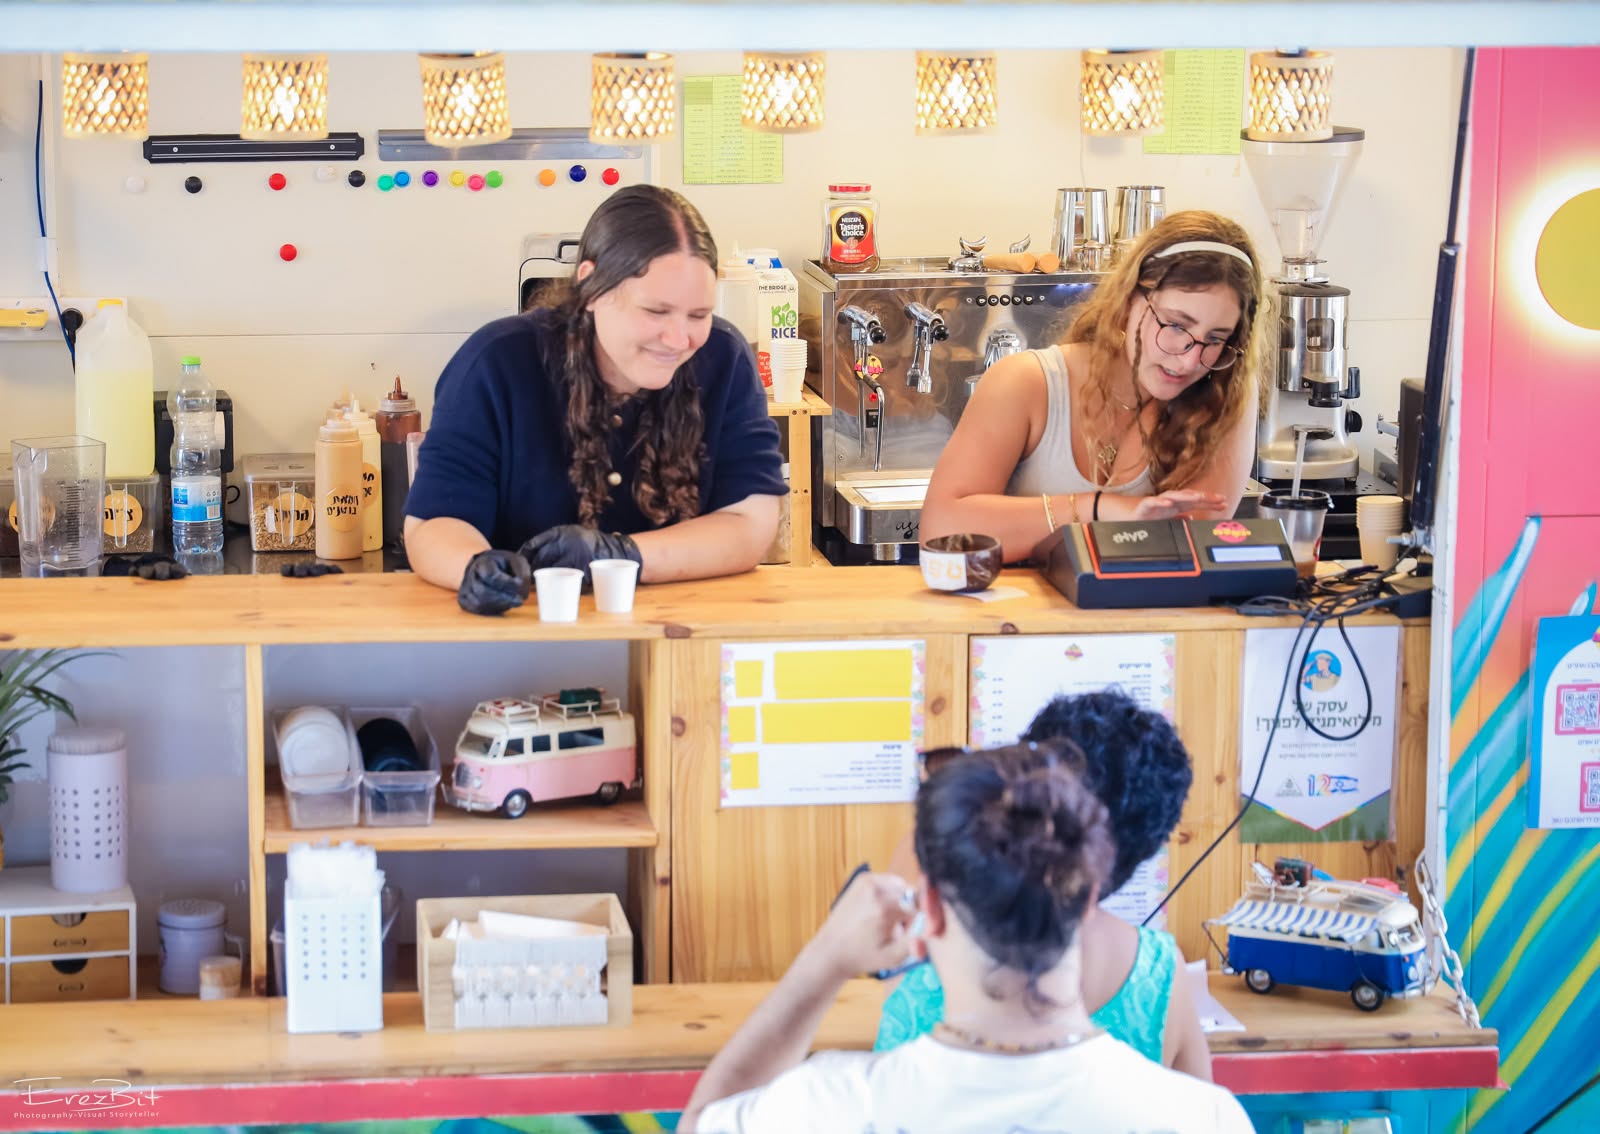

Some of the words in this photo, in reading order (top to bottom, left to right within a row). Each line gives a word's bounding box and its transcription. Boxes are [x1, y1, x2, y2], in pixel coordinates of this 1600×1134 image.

[840, 223, 865, 231] Taster's
[771, 327, 796, 339] RICE
[1316, 700, 1348, 715] עסק
[1304, 713, 1382, 730] מלואימניק
